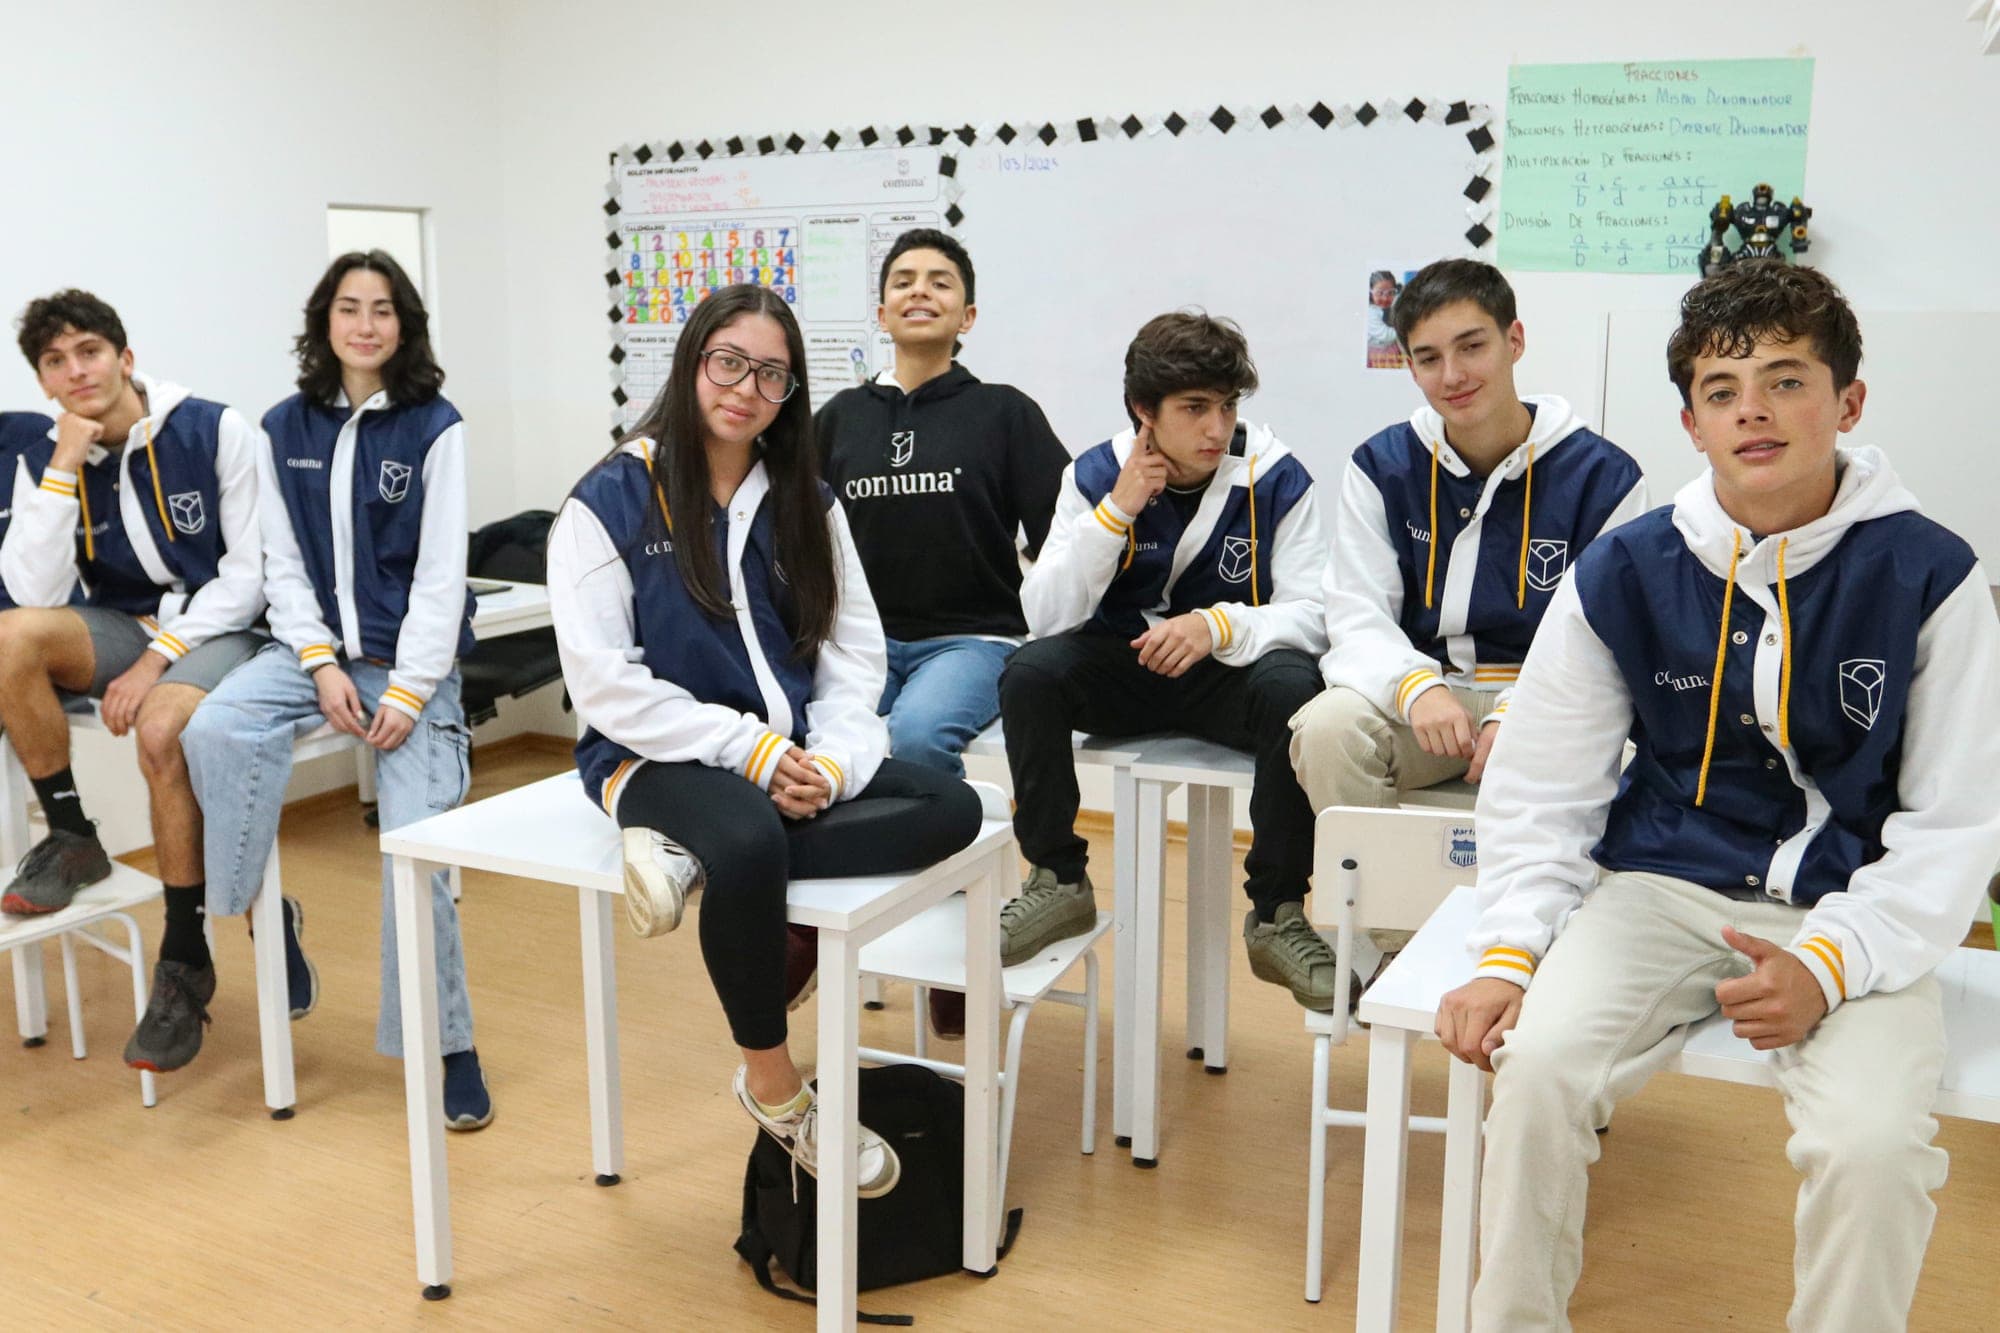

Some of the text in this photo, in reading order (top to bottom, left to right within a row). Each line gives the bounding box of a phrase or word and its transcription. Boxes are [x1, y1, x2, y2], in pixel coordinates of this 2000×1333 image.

[1623, 62, 1699, 83] FRACCIONES
[1510, 85, 1566, 105] FRACCIONES
[1706, 87, 1793, 106] DENOMINADOR
[1506, 118, 1566, 137] FRACCIONES
[1730, 115, 1807, 136] DENOMINADOR
[1601, 152, 1615, 168] DE
[1569, 213, 1583, 229] DE
[632, 233, 640, 251] 1
[652, 234, 664, 251] 2
[677, 231, 689, 250] 3
[702, 231, 714, 249] 4
[728, 230, 739, 248] 5
[754, 229, 764, 248] 6
[778, 228, 789, 247] 7
[631, 252, 641, 270] 8
[655, 251, 666, 270] 9
[672, 250, 692, 268] 10
[699, 249, 716, 268] 11
[725, 248, 744, 267] 12
[749, 248, 769, 267] 13
[775, 248, 795, 266] 14
[624, 270, 645, 288] 15
[674, 269, 694, 287] 17
[724, 267, 744, 285] 19
[749, 266, 773, 286] 20
[773, 266, 795, 285] 21
[626, 287, 648, 306] 22
[650, 287, 671, 304] 23
[674, 287, 696, 305] 24
[649, 304, 672, 324] 30
